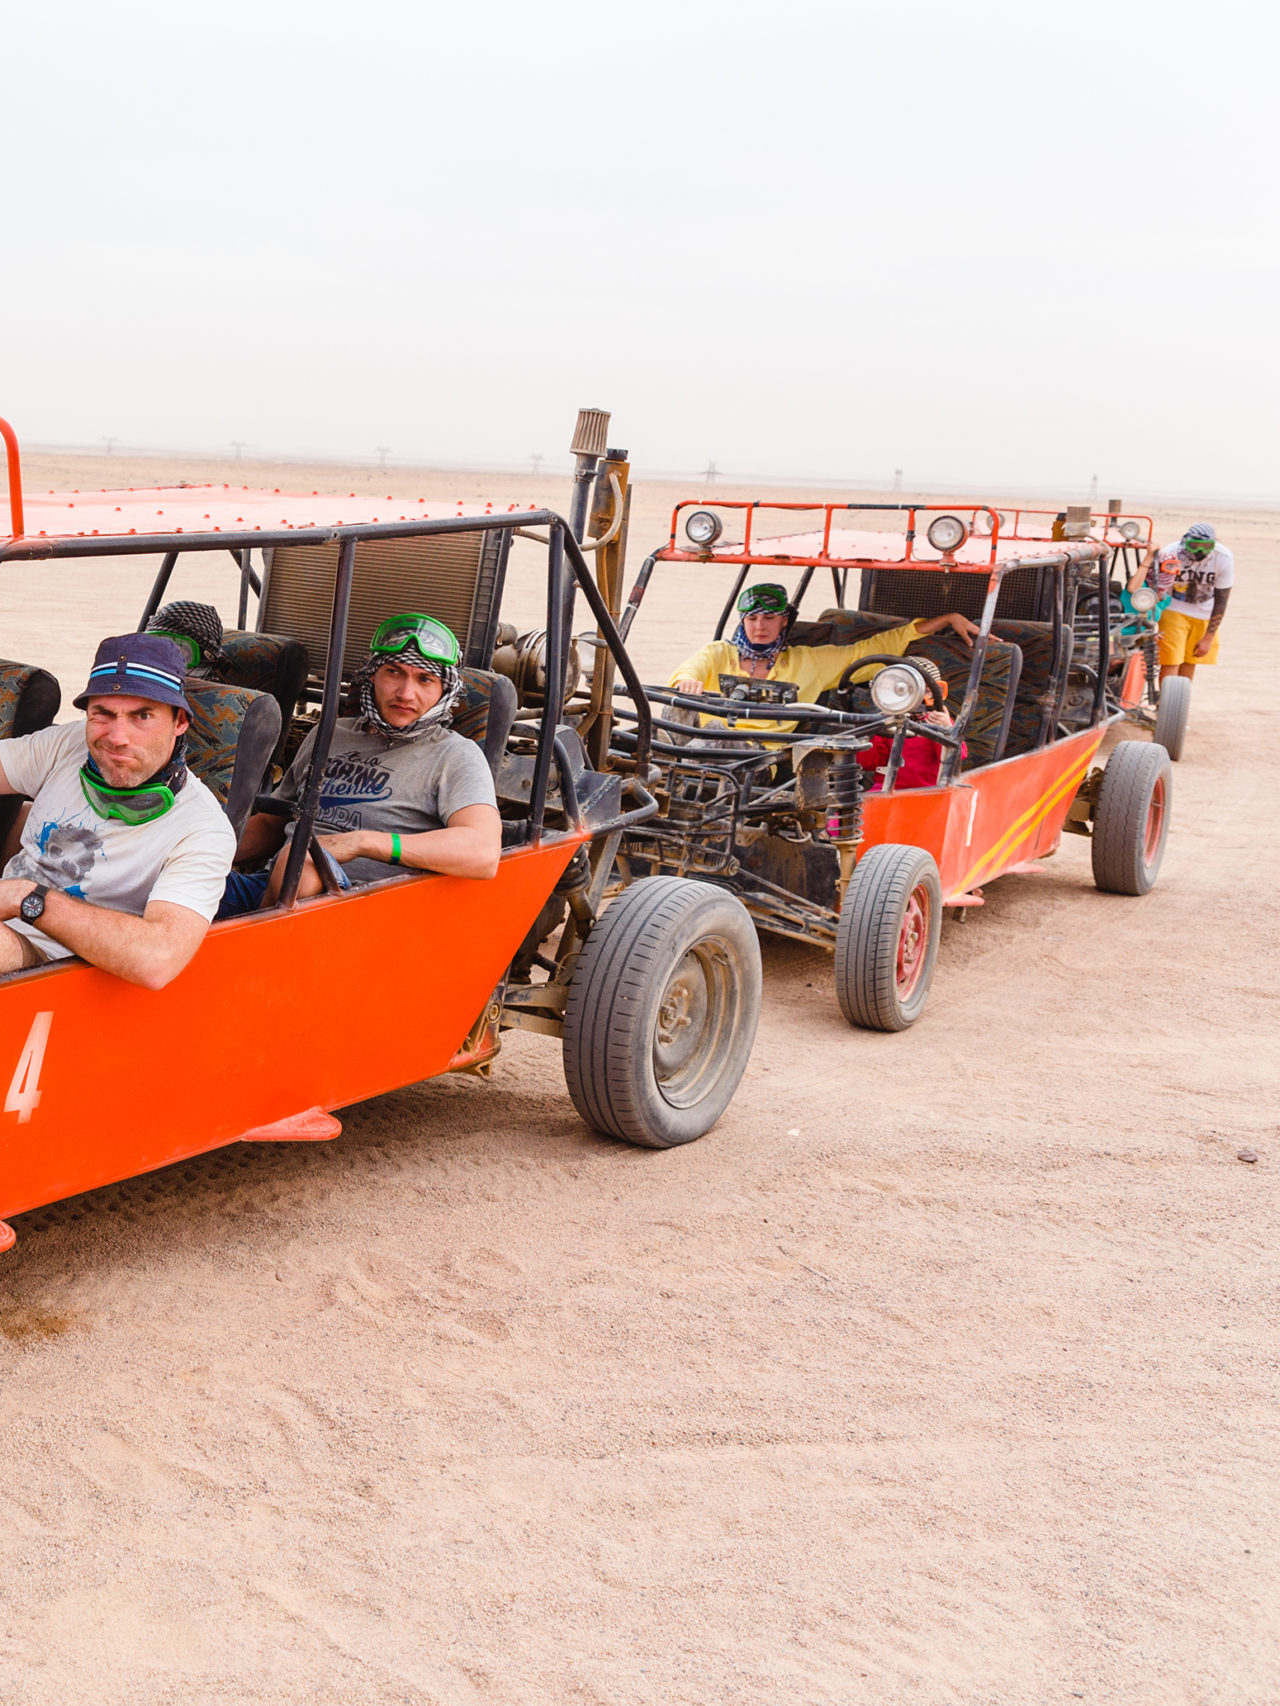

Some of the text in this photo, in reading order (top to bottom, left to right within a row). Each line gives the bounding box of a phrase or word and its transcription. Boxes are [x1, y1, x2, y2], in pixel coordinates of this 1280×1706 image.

[1175, 569, 1216, 585] KING
[317, 806, 362, 831] PPA
[3, 1010, 54, 1124] 4
